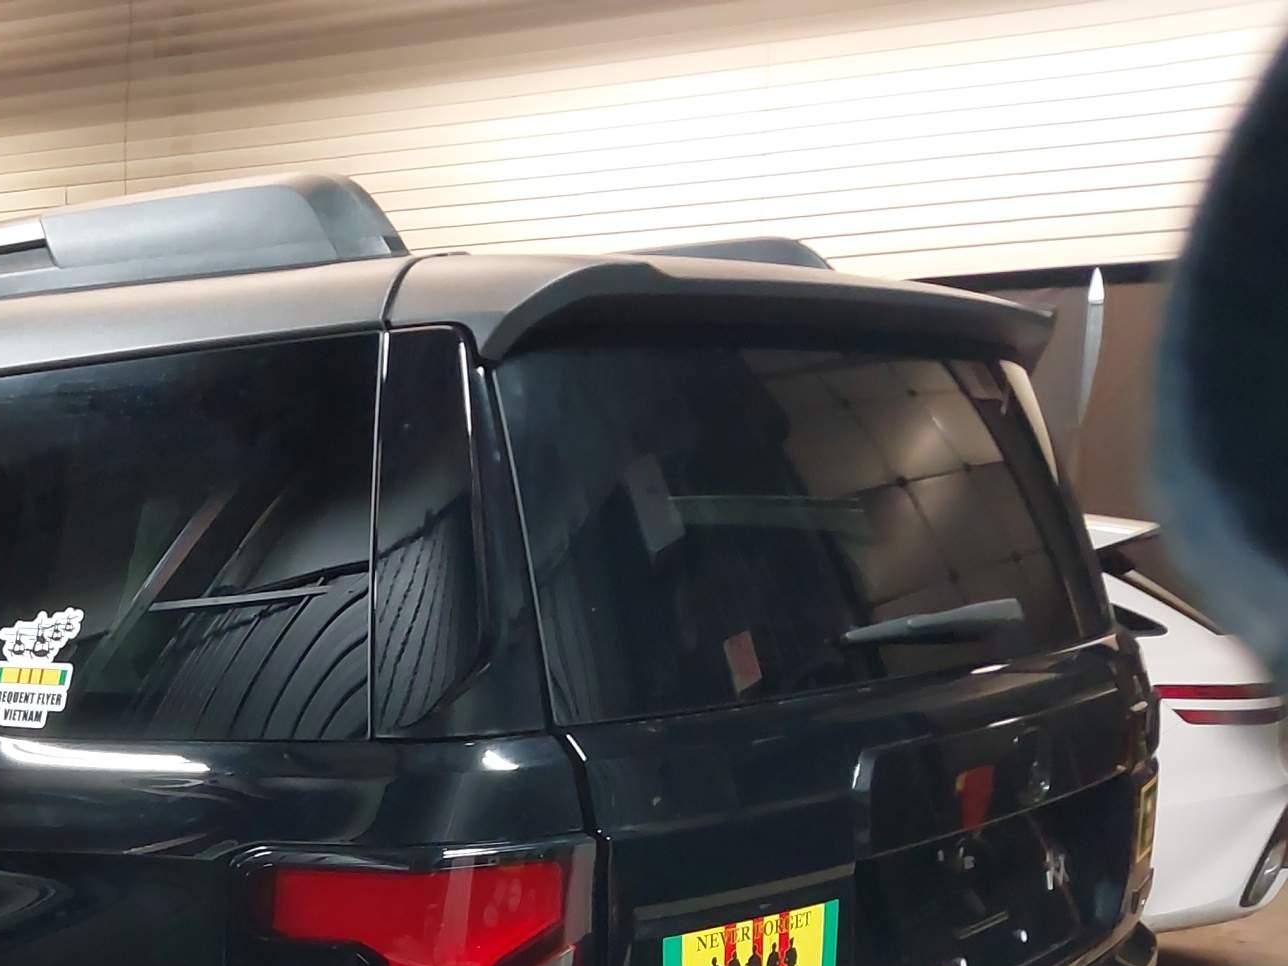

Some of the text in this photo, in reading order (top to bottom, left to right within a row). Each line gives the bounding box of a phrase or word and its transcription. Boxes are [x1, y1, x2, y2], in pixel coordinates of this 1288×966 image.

[37, 692, 62, 705] FLYER
[3, 709, 42, 722] VIETNAM
[696, 910, 813, 953] NEVER FORGET
